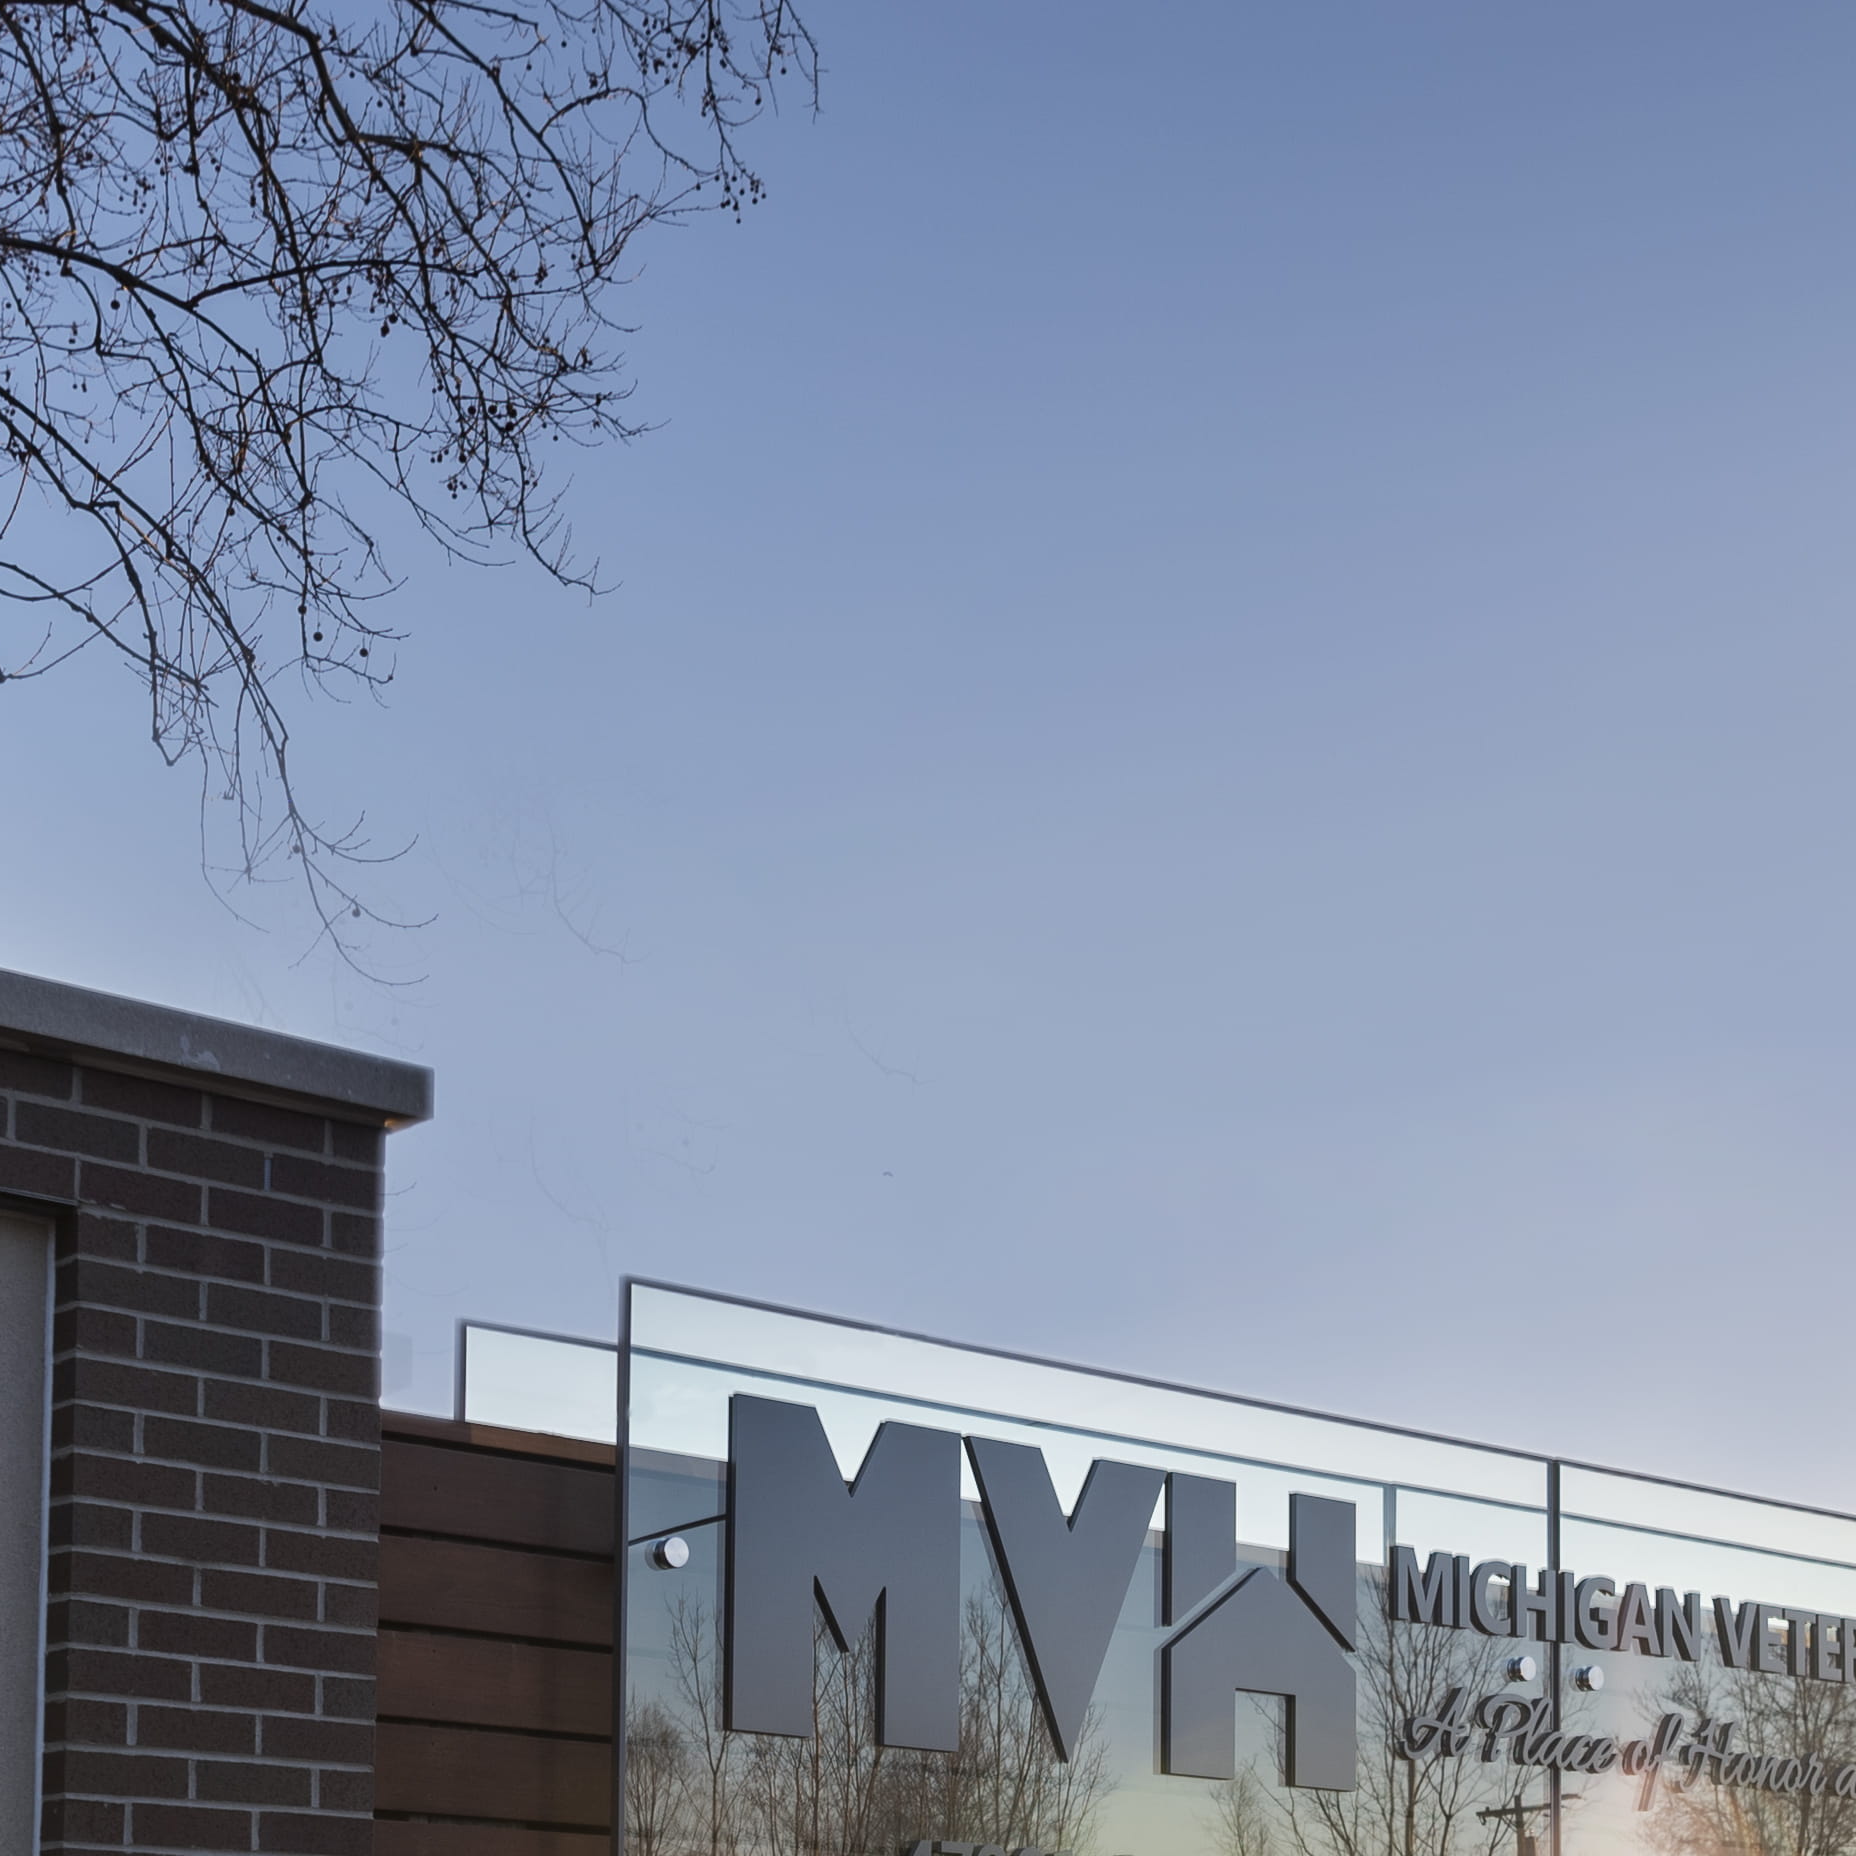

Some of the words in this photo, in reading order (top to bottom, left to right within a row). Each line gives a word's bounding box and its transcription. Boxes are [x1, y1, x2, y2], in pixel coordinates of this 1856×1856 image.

[724, 1393, 1357, 1791] MVH
[1390, 1545, 1701, 1661] MICHIGAN
[1397, 1687, 1469, 1760] A
[1475, 1693, 1618, 1774] Place
[1621, 1713, 1684, 1812] of
[1676, 1718, 1828, 1796] Honor
